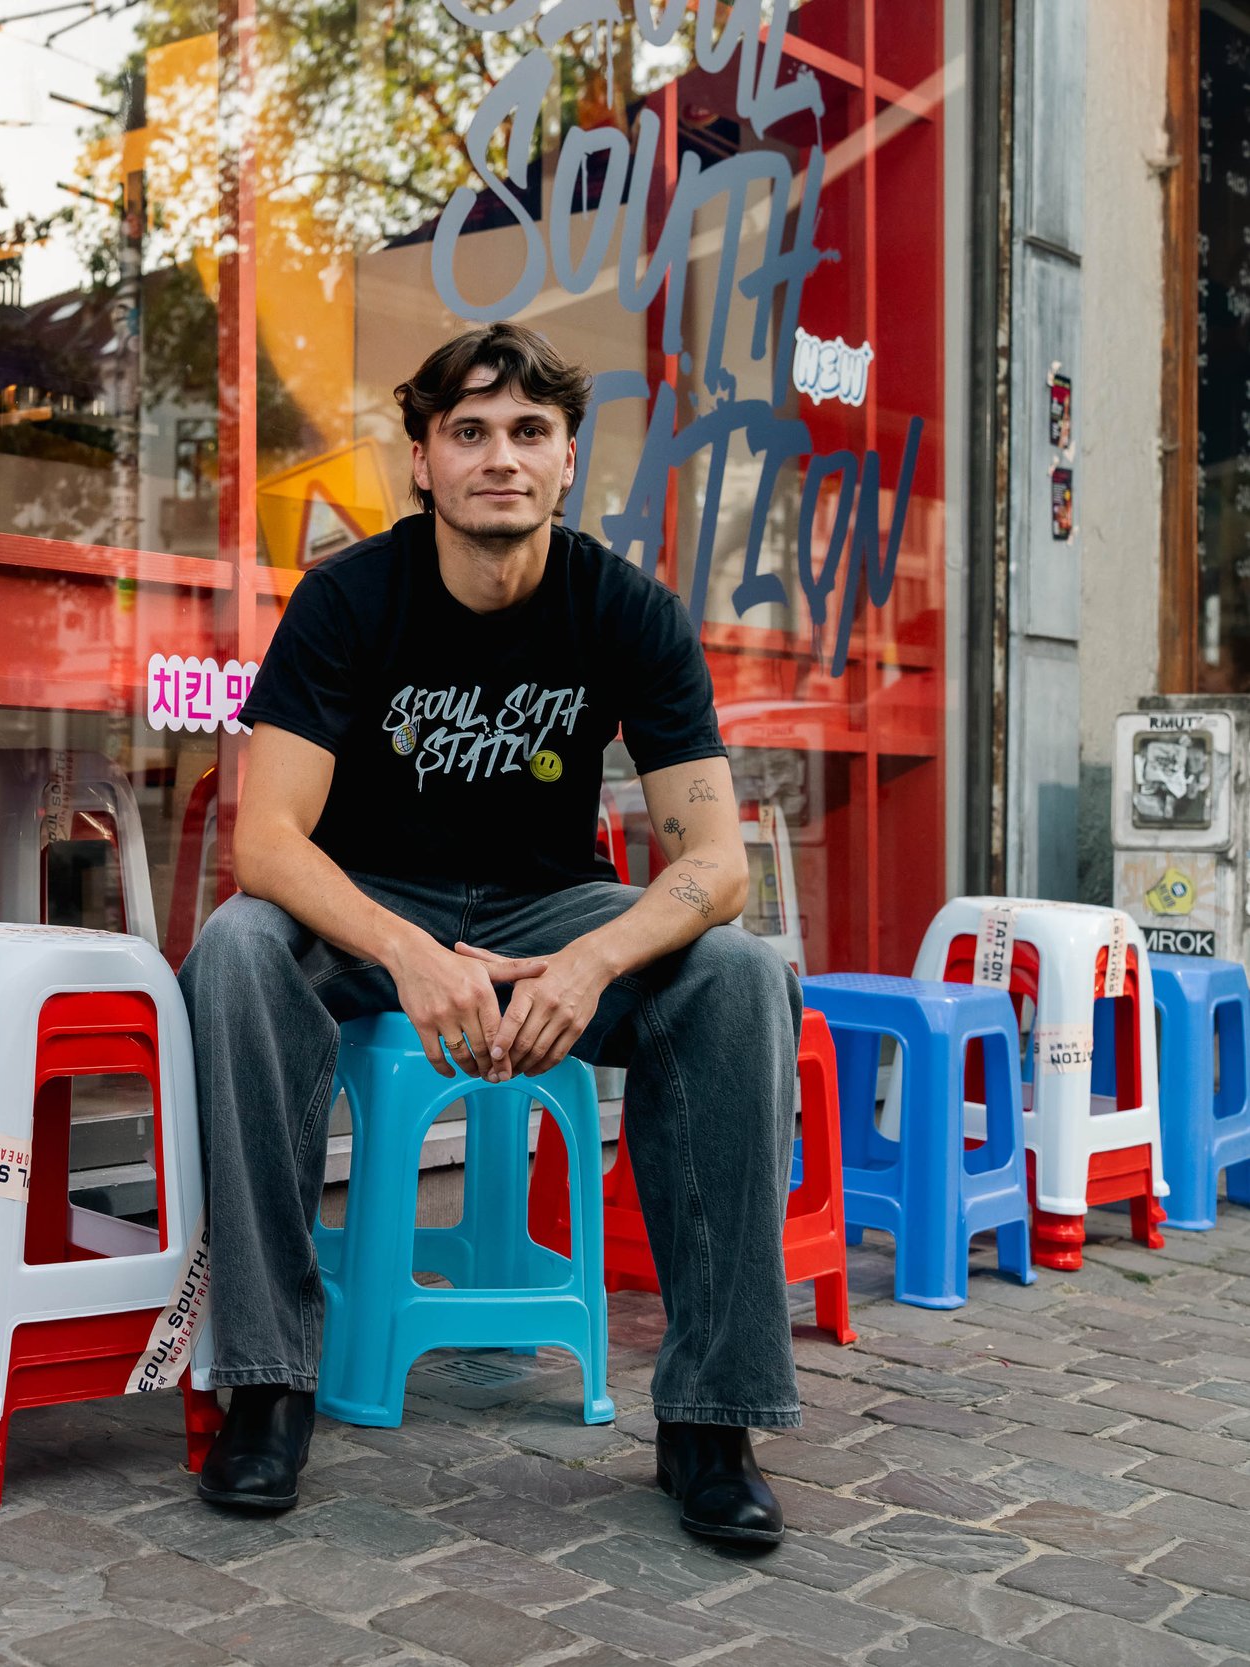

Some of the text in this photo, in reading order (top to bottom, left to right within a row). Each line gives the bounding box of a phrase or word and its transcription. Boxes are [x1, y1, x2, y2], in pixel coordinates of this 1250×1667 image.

[432, 48, 838, 407] SOUTH
[796, 334, 868, 402] NEW
[575, 370, 924, 678] TATION
[153, 668, 212, 720] 치킨
[382, 682, 589, 736] SEOUL SUTH
[991, 909, 1009, 982] TATION
[168, 1249, 208, 1330] SOUTH
[168, 1310, 199, 1364] KOREAN
